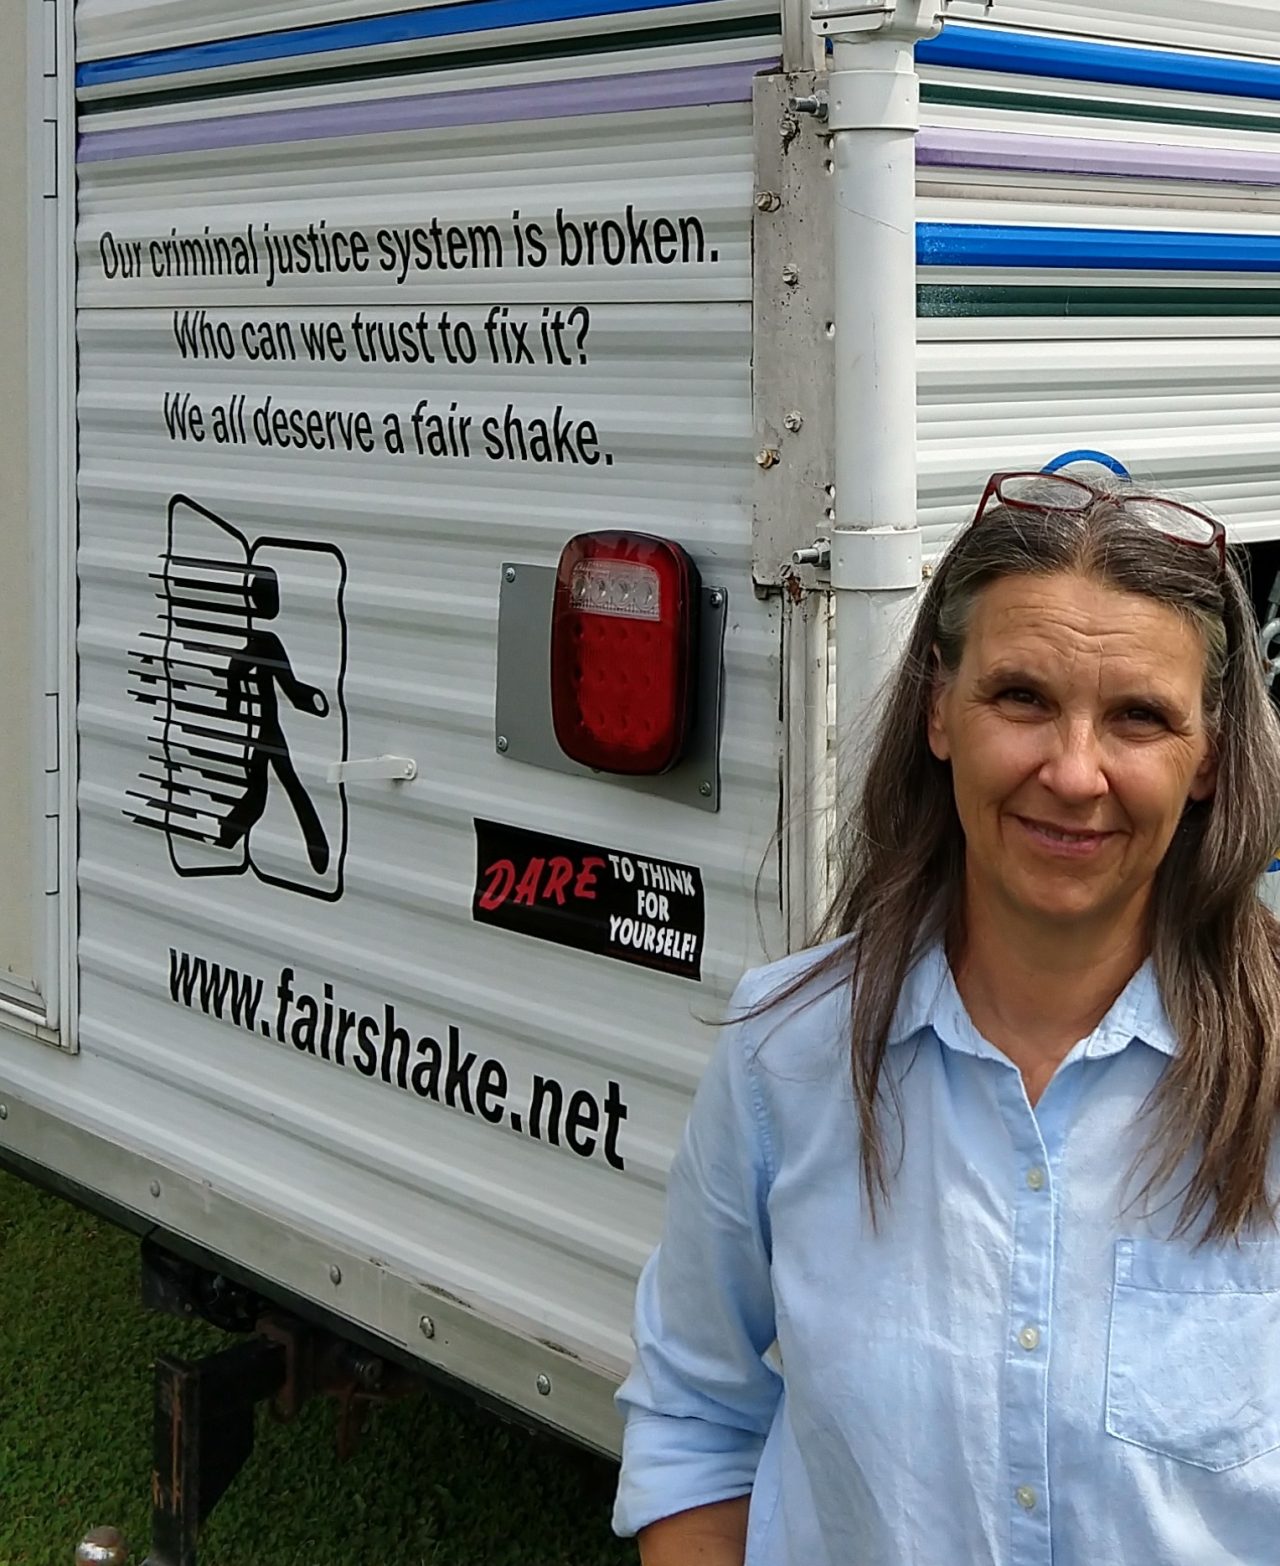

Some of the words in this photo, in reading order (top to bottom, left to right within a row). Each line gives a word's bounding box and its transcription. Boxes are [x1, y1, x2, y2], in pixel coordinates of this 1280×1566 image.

[99, 231, 142, 279] Our
[149, 223, 259, 278] criminal
[263, 219, 370, 287] justice
[376, 217, 503, 285] system
[512, 210, 547, 268] is
[556, 204, 719, 267] broken.
[173, 310, 236, 360] Who
[241, 321, 296, 361] can
[300, 322, 347, 362] we
[351, 311, 435, 364] trust
[437, 311, 477, 364] to
[484, 305, 535, 365] fix
[540, 305, 591, 366] it?
[163, 392, 206, 442] We
[211, 394, 247, 445] all
[253, 395, 375, 453] deserve
[382, 413, 405, 454] a
[411, 399, 472, 458] fair
[482, 404, 614, 466] shake.
[478, 855, 606, 911] DARE
[608, 853, 635, 883] TO
[636, 859, 697, 897] THINK
[637, 889, 670, 922] FOR
[609, 914, 697, 963] YOURSELF!
[169, 946, 629, 1171] www.fairshake.net
